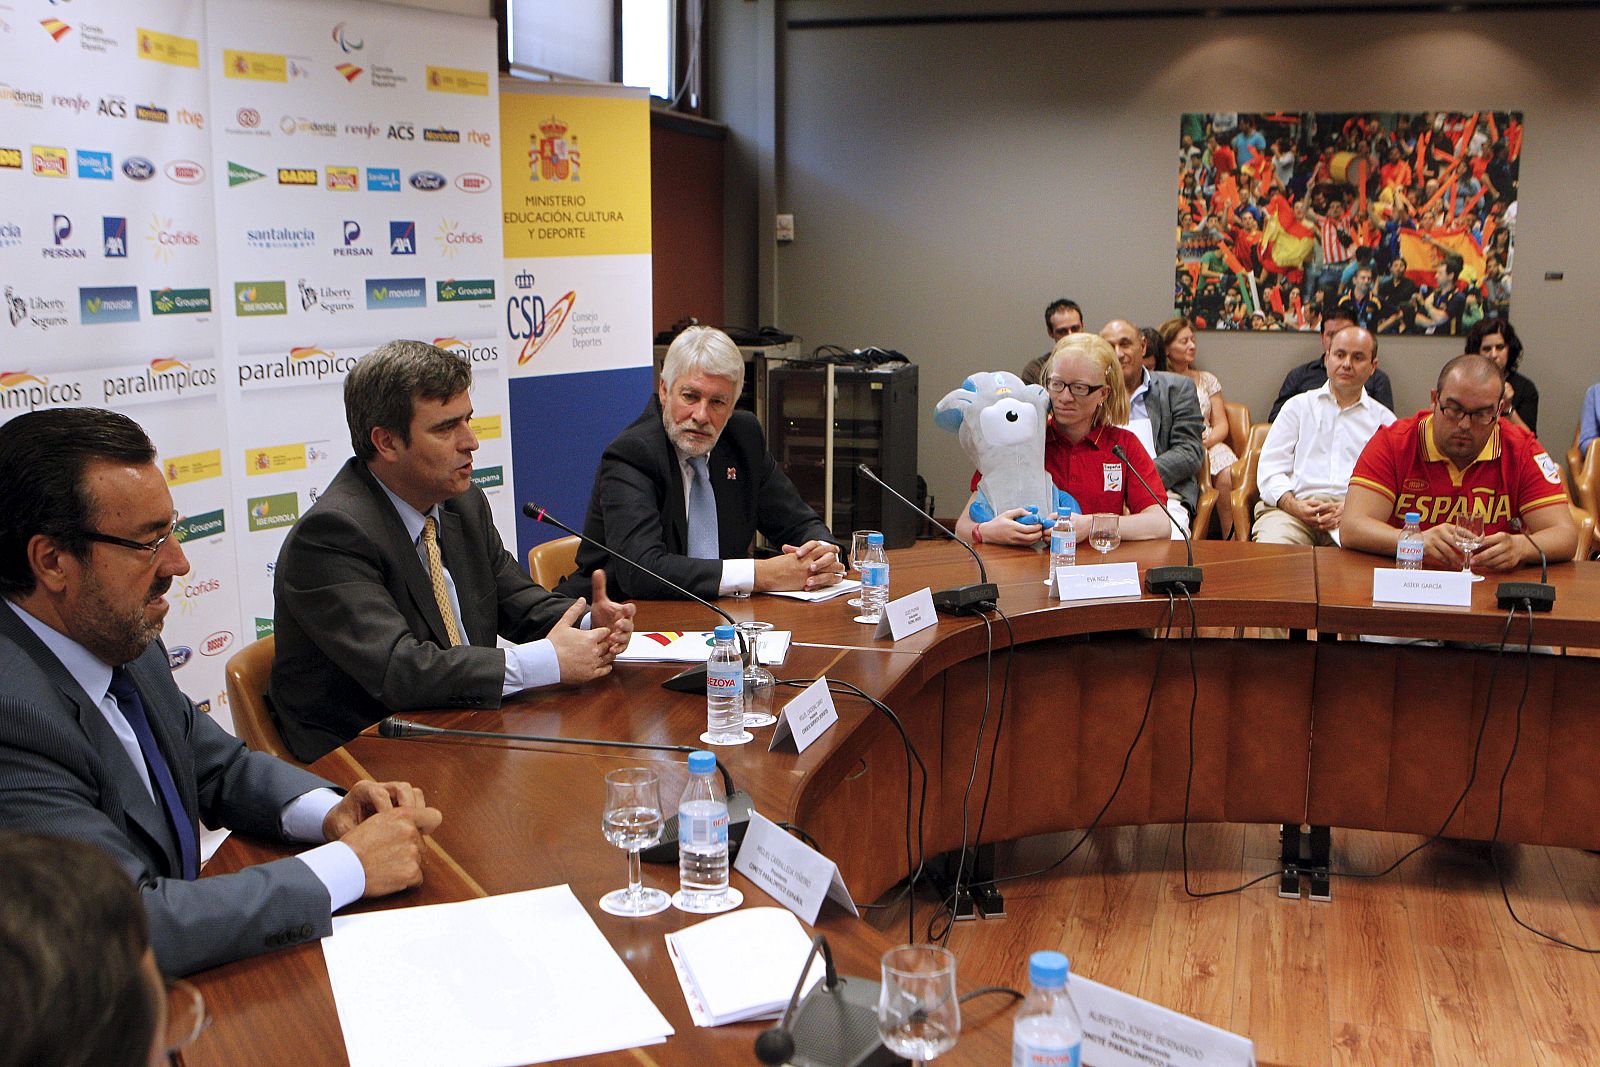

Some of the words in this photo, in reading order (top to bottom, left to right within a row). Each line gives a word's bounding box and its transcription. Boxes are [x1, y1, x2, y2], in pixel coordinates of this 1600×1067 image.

[98, 98, 128, 119] ACS
[177, 107, 205, 129] rtve
[387, 125, 415, 140] ACS
[467, 129, 491, 147] rtve
[525, 195, 586, 207] MINISTERIO
[503, 211, 575, 224] EDUCACIÓN,
[575, 211, 624, 223] CULTURA
[157, 231, 200, 246] Cofidis
[446, 232, 484, 244] Cofidis
[528, 228, 535, 240] Y
[538, 227, 586, 239] DEPORTE
[105, 236, 127, 258] AXA
[333, 247, 374, 257] PERSAN
[391, 237, 413, 253] AXA
[42, 248, 87, 260] PERSAN
[320, 287, 352, 301] Liberty
[388, 287, 421, 298] movistar
[457, 286, 493, 297] Groupama
[29, 296, 66, 314] Liberty
[103, 298, 134, 312] movistar
[174, 296, 210, 309] Groupama
[243, 302, 285, 313] IBERDROLA
[320, 302, 355, 315] Seguros
[31, 315, 69, 331] Seguros
[507, 295, 546, 340] CSD
[571, 311, 599, 324] Consejo
[572, 323, 600, 337] Superior
[602, 322, 611, 333] de
[572, 337, 602, 350] Deportes
[1395, 487, 1512, 524] ESPAÑA
[189, 518, 222, 533] Groupama
[255, 513, 296, 526] IBERDROLA
[184, 577, 220, 598] Cofidis
[707, 677, 736, 688] BEZOYA
